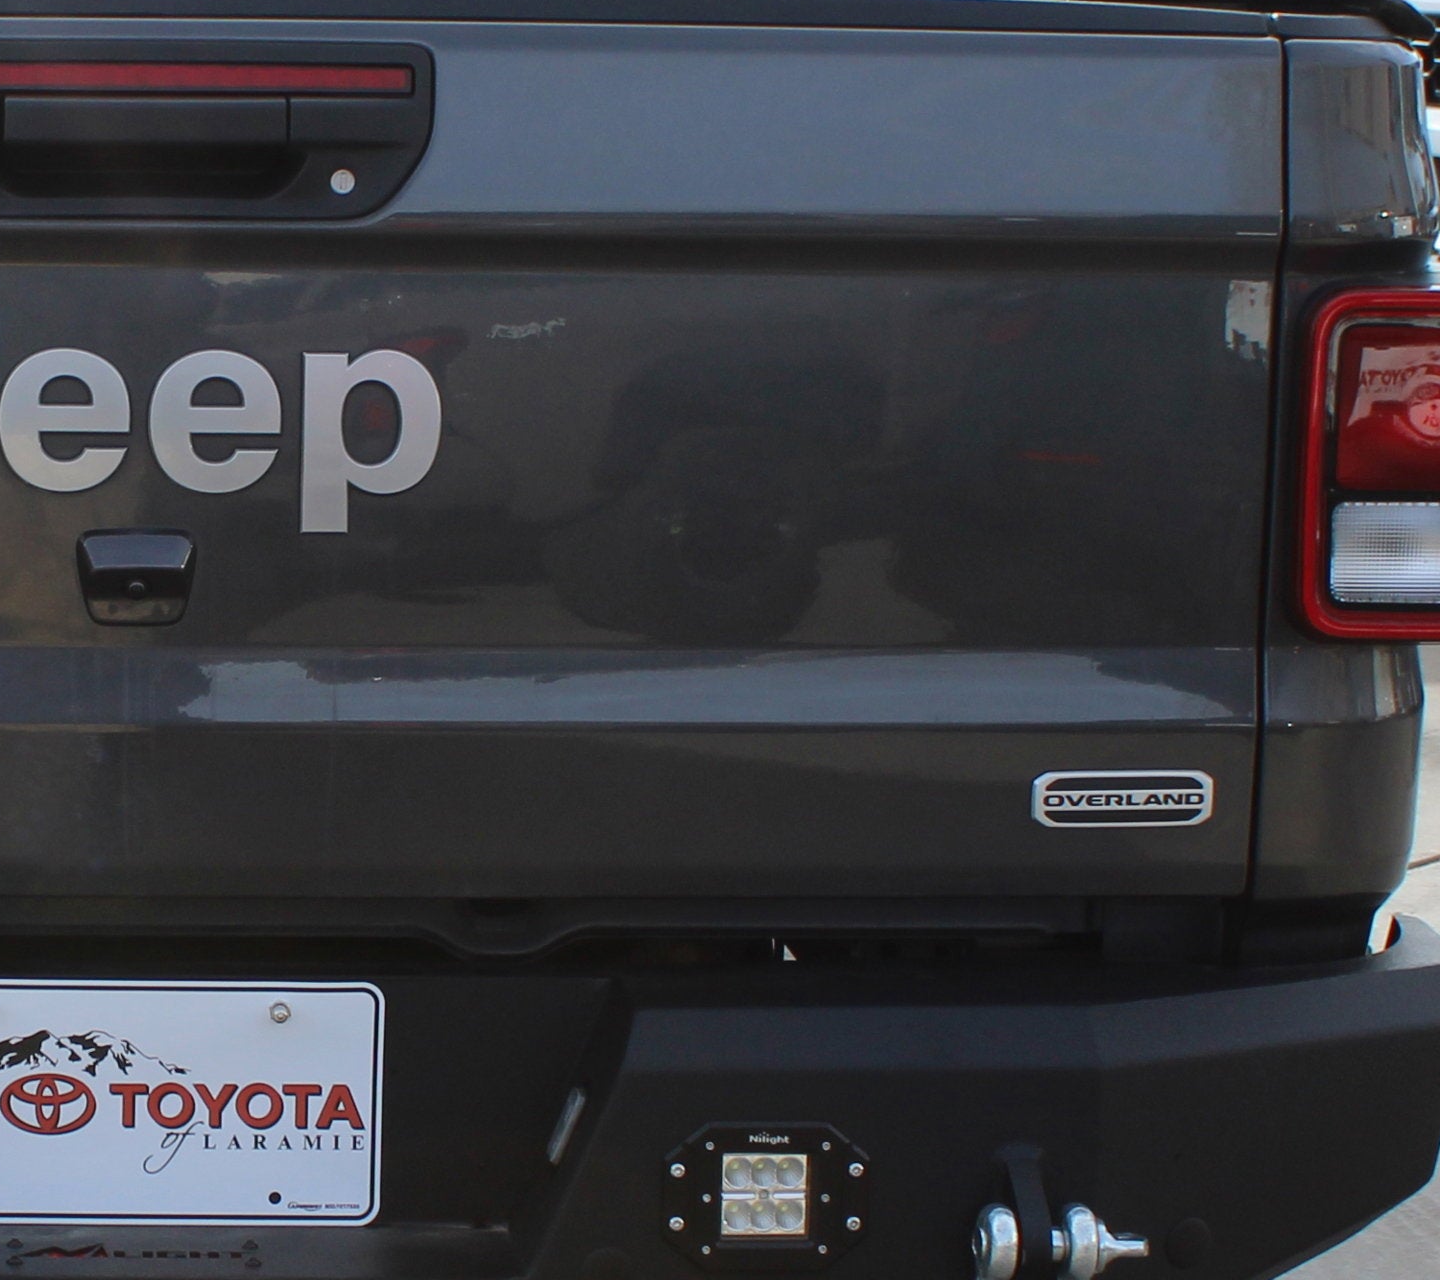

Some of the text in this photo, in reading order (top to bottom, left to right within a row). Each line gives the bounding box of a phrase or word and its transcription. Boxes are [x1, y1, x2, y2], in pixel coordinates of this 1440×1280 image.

[1042, 793, 1205, 808] OVERLAND
[108, 1082, 366, 1131] TOYOTA
[143, 1121, 366, 1175] of LARAMIE
[748, 1131, 791, 1146] Nilight
